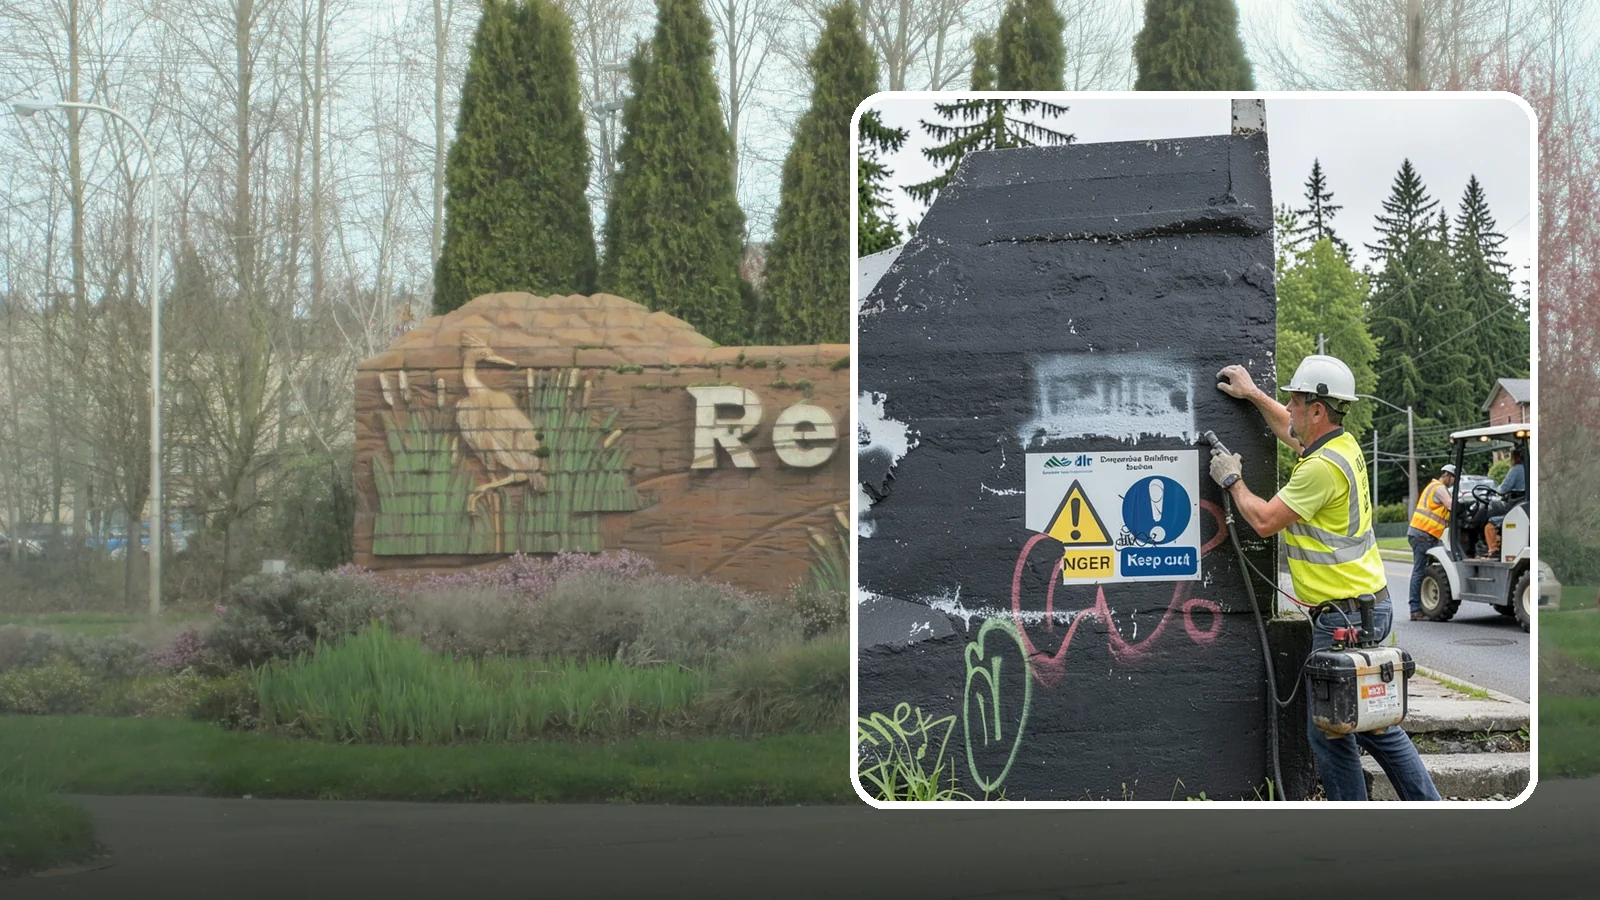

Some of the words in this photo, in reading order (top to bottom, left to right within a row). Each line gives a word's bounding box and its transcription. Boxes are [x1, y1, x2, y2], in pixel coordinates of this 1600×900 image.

[686, 385, 838, 469] Re
[1063, 556, 1110, 571] NGER
[1127, 553, 1161, 569] Keep
